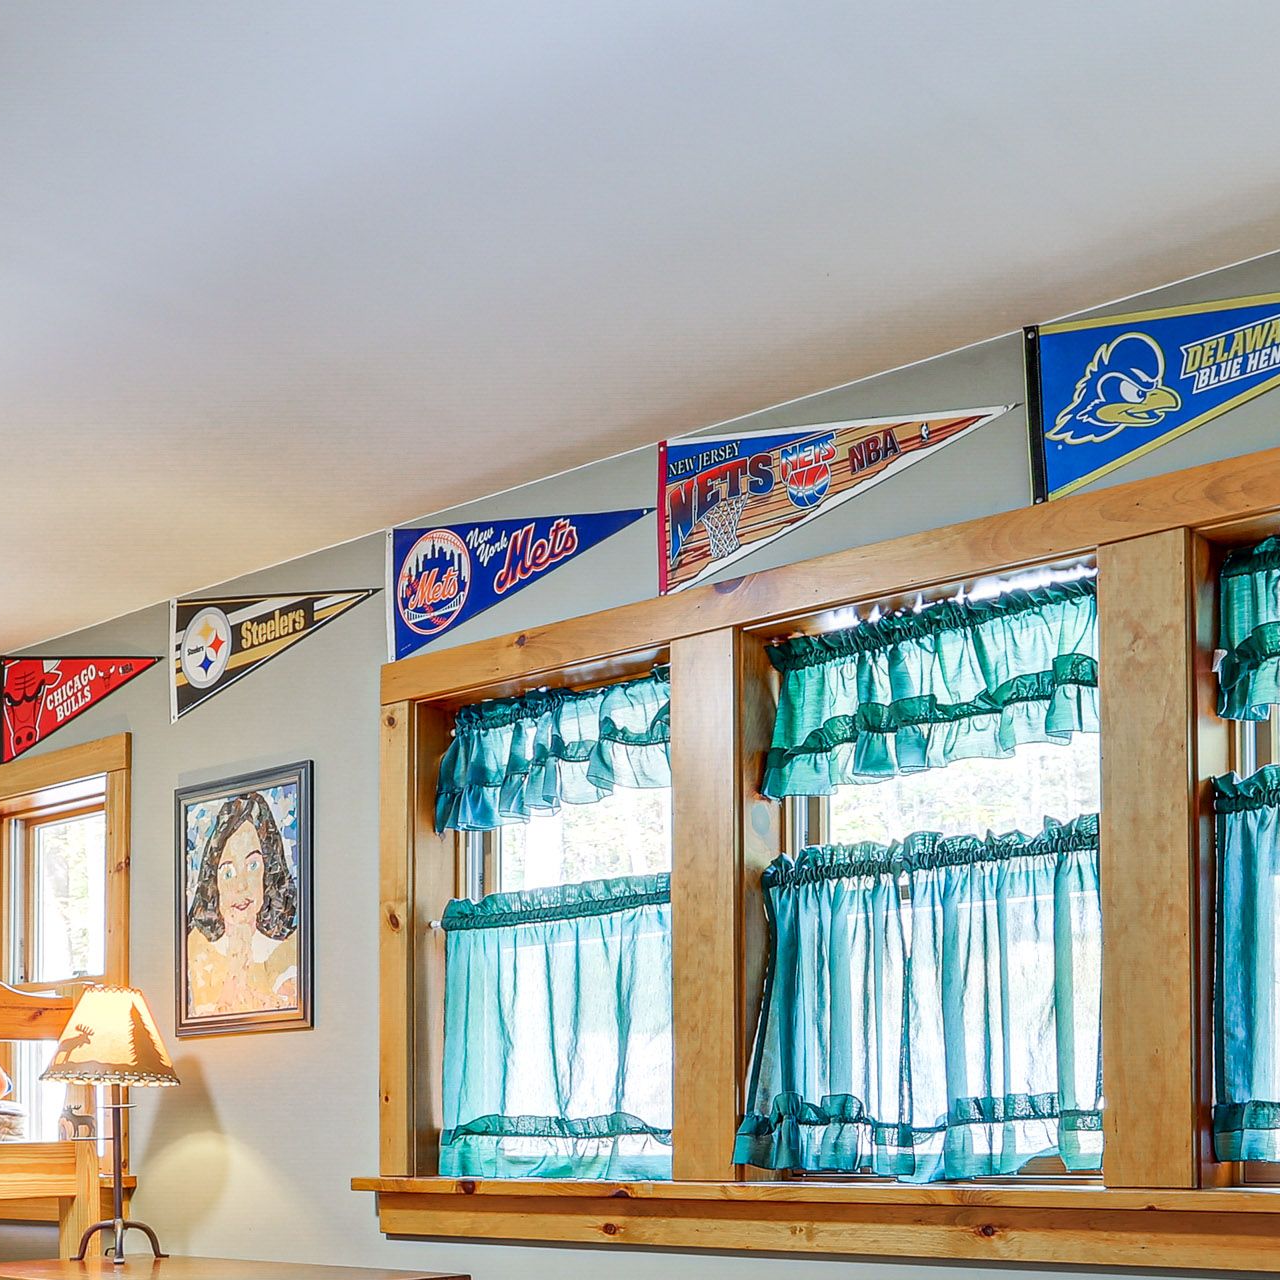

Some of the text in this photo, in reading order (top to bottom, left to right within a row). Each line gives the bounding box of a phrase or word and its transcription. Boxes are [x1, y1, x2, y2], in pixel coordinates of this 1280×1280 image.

[1197, 356, 1243, 389] BLUE
[668, 441, 741, 477] NEW JERSEY
[779, 431, 838, 485] NETS
[848, 428, 901, 475] NBA
[670, 452, 775, 566] NETS
[466, 526, 494, 549] New
[476, 530, 509, 567] York
[493, 517, 578, 595] Mets
[409, 567, 460, 610] Mets
[241, 608, 305, 649] Steelers
[46, 664, 97, 711] CHICAGO
[55, 685, 92, 722] BULLS
